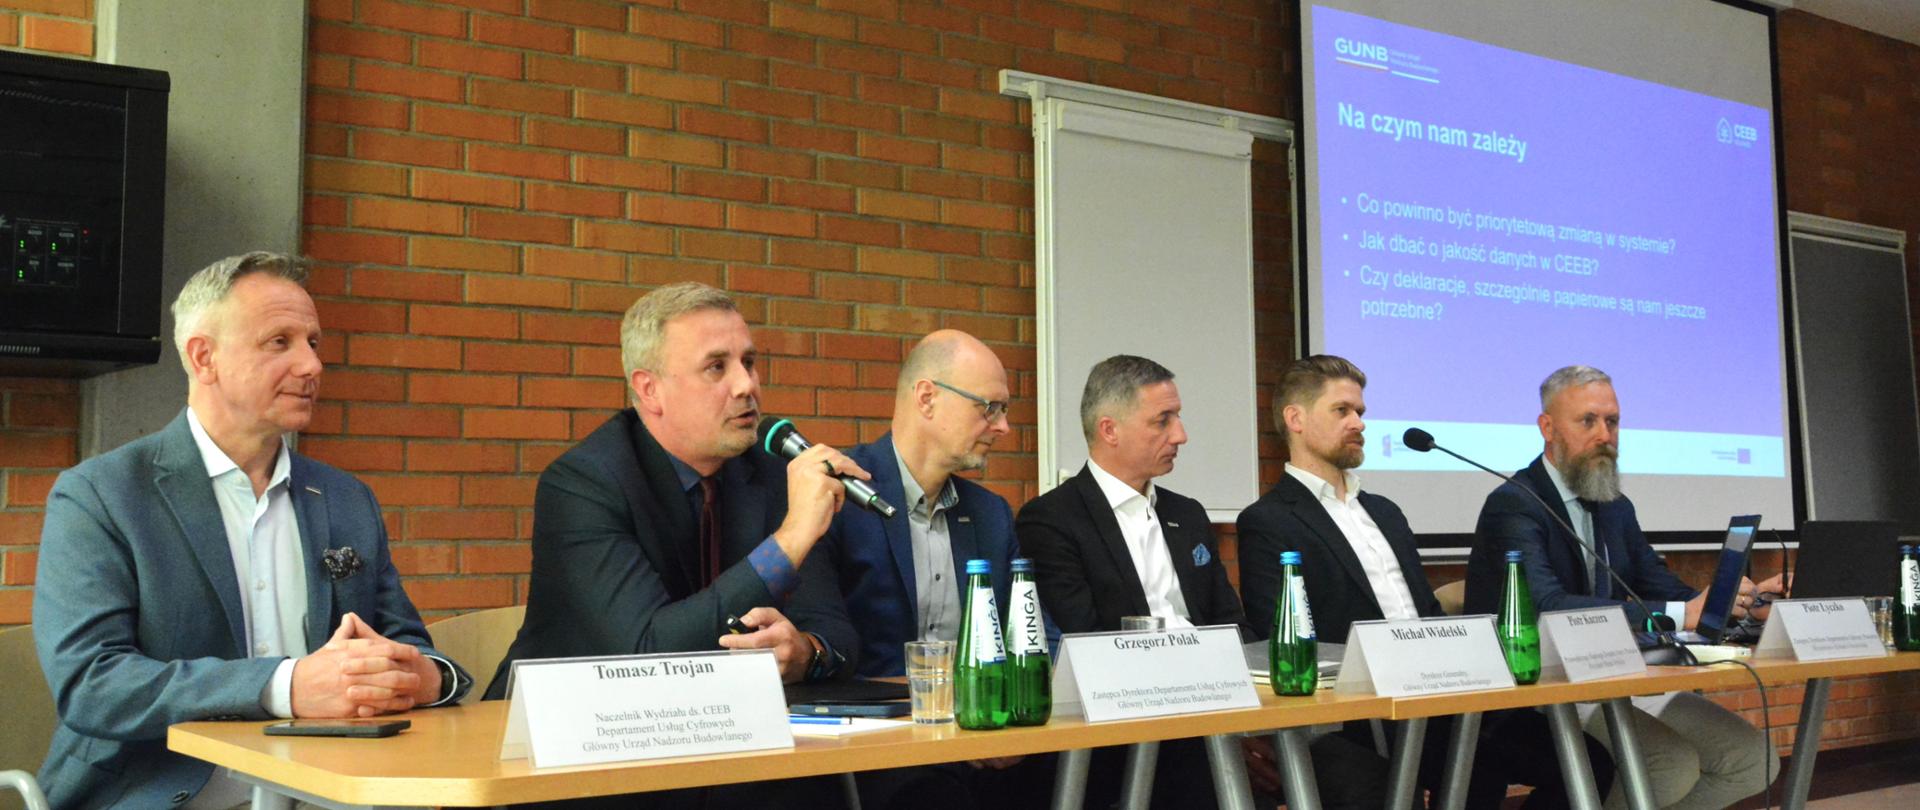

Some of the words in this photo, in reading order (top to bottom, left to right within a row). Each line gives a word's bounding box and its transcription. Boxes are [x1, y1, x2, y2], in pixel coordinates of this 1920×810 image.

[1335, 37, 1389, 62] GUNB
[1338, 101, 1365, 129] Na
[1371, 112, 1423, 142] czym
[1428, 123, 1468, 147] nam
[1472, 131, 1527, 163] zależy
[1734, 124, 1757, 141] CEEB
[1357, 192, 1380, 214] Co
[1383, 200, 1444, 222] powinno
[1448, 206, 1473, 230] być
[1476, 212, 1555, 242] priorytetową
[1558, 224, 1603, 248] zmianą
[1606, 232, 1616, 247] w
[1619, 233, 1676, 255] systemie?
[1359, 229, 1385, 251] Jak
[1389, 234, 1425, 256] dbać
[1428, 241, 1438, 257] o
[1441, 240, 1487, 262] jakość
[1489, 245, 1537, 271] danych
[1540, 256, 1550, 270] w
[1554, 254, 1599, 276] CEEB?
[1360, 265, 1389, 291] Czy
[1393, 269, 1470, 298] deklaracje,
[1474, 280, 1550, 304] szczególnie
[1553, 288, 1617, 310] papierowe
[1619, 297, 1635, 316] są
[1636, 298, 1663, 315] nam
[1664, 301, 1706, 320] jeszcze
[1361, 299, 1444, 321] potrzebne?
[1023, 589, 1039, 646] KINGA
[1114, 635, 1166, 651] Grzegorz
[1168, 633, 1200, 646] Polak
[1426, 625, 1468, 638] Widelski
[593, 664, 658, 680] Tomasz
[659, 660, 715, 678] Trojan
[595, 711, 642, 723] Naczelnik
[643, 708, 686, 721] Wydziału
[688, 706, 701, 716] ds.
[703, 704, 731, 715] CEEB
[597, 723, 656, 737] Departament
[657, 720, 685, 733] Usług
[686, 717, 735, 730] Cyfrowych
[582, 740, 620, 752] Główny
[621, 737, 651, 750] Urząd
[653, 734, 692, 747] Nadzoru
[693, 730, 753, 744] Budowlanego
